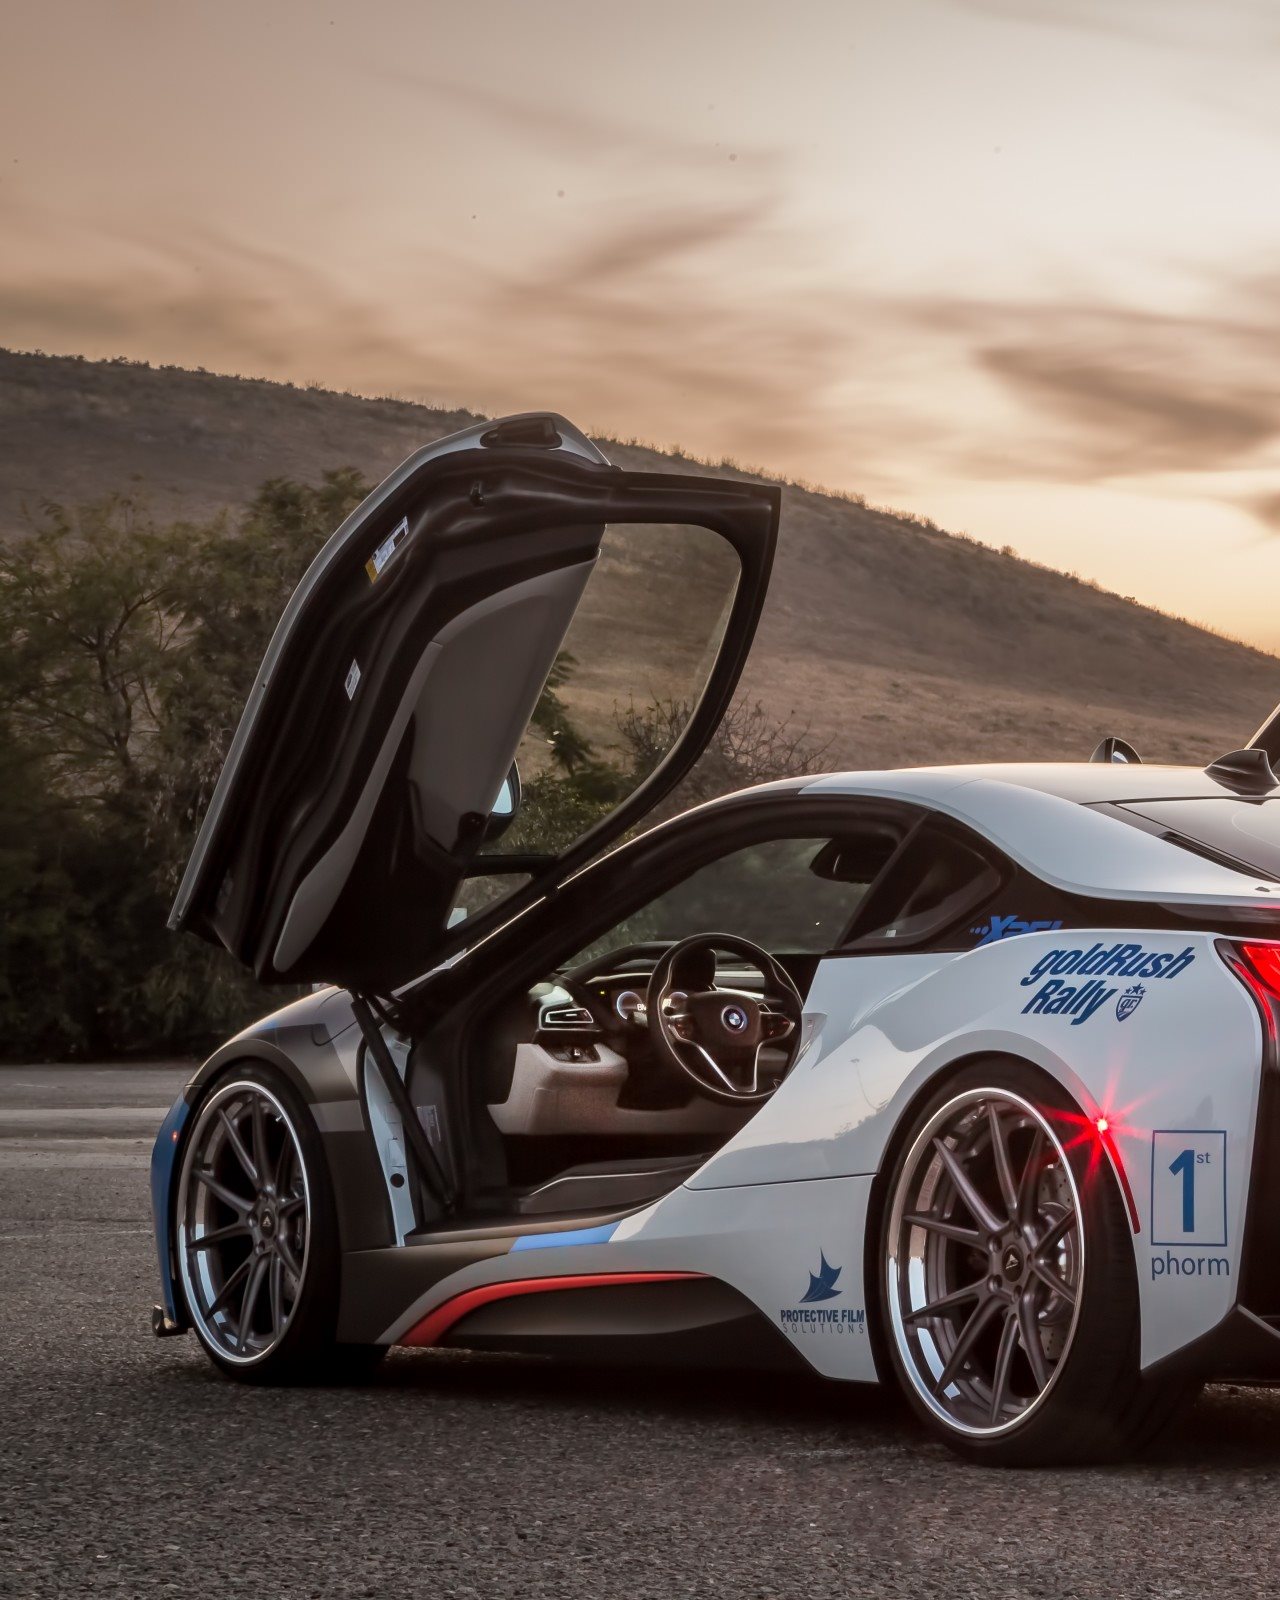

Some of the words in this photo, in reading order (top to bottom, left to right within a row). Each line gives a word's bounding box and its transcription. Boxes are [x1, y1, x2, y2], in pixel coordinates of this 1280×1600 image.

[1020, 943, 1195, 986] goldRush
[1021, 979, 1118, 1025] Rally
[1151, 1250, 1230, 1281] phorm
[780, 1309, 839, 1323] PROTECTIVE
[841, 1309, 865, 1323] FILM
[782, 1323, 864, 1334] SOLUTIONS
